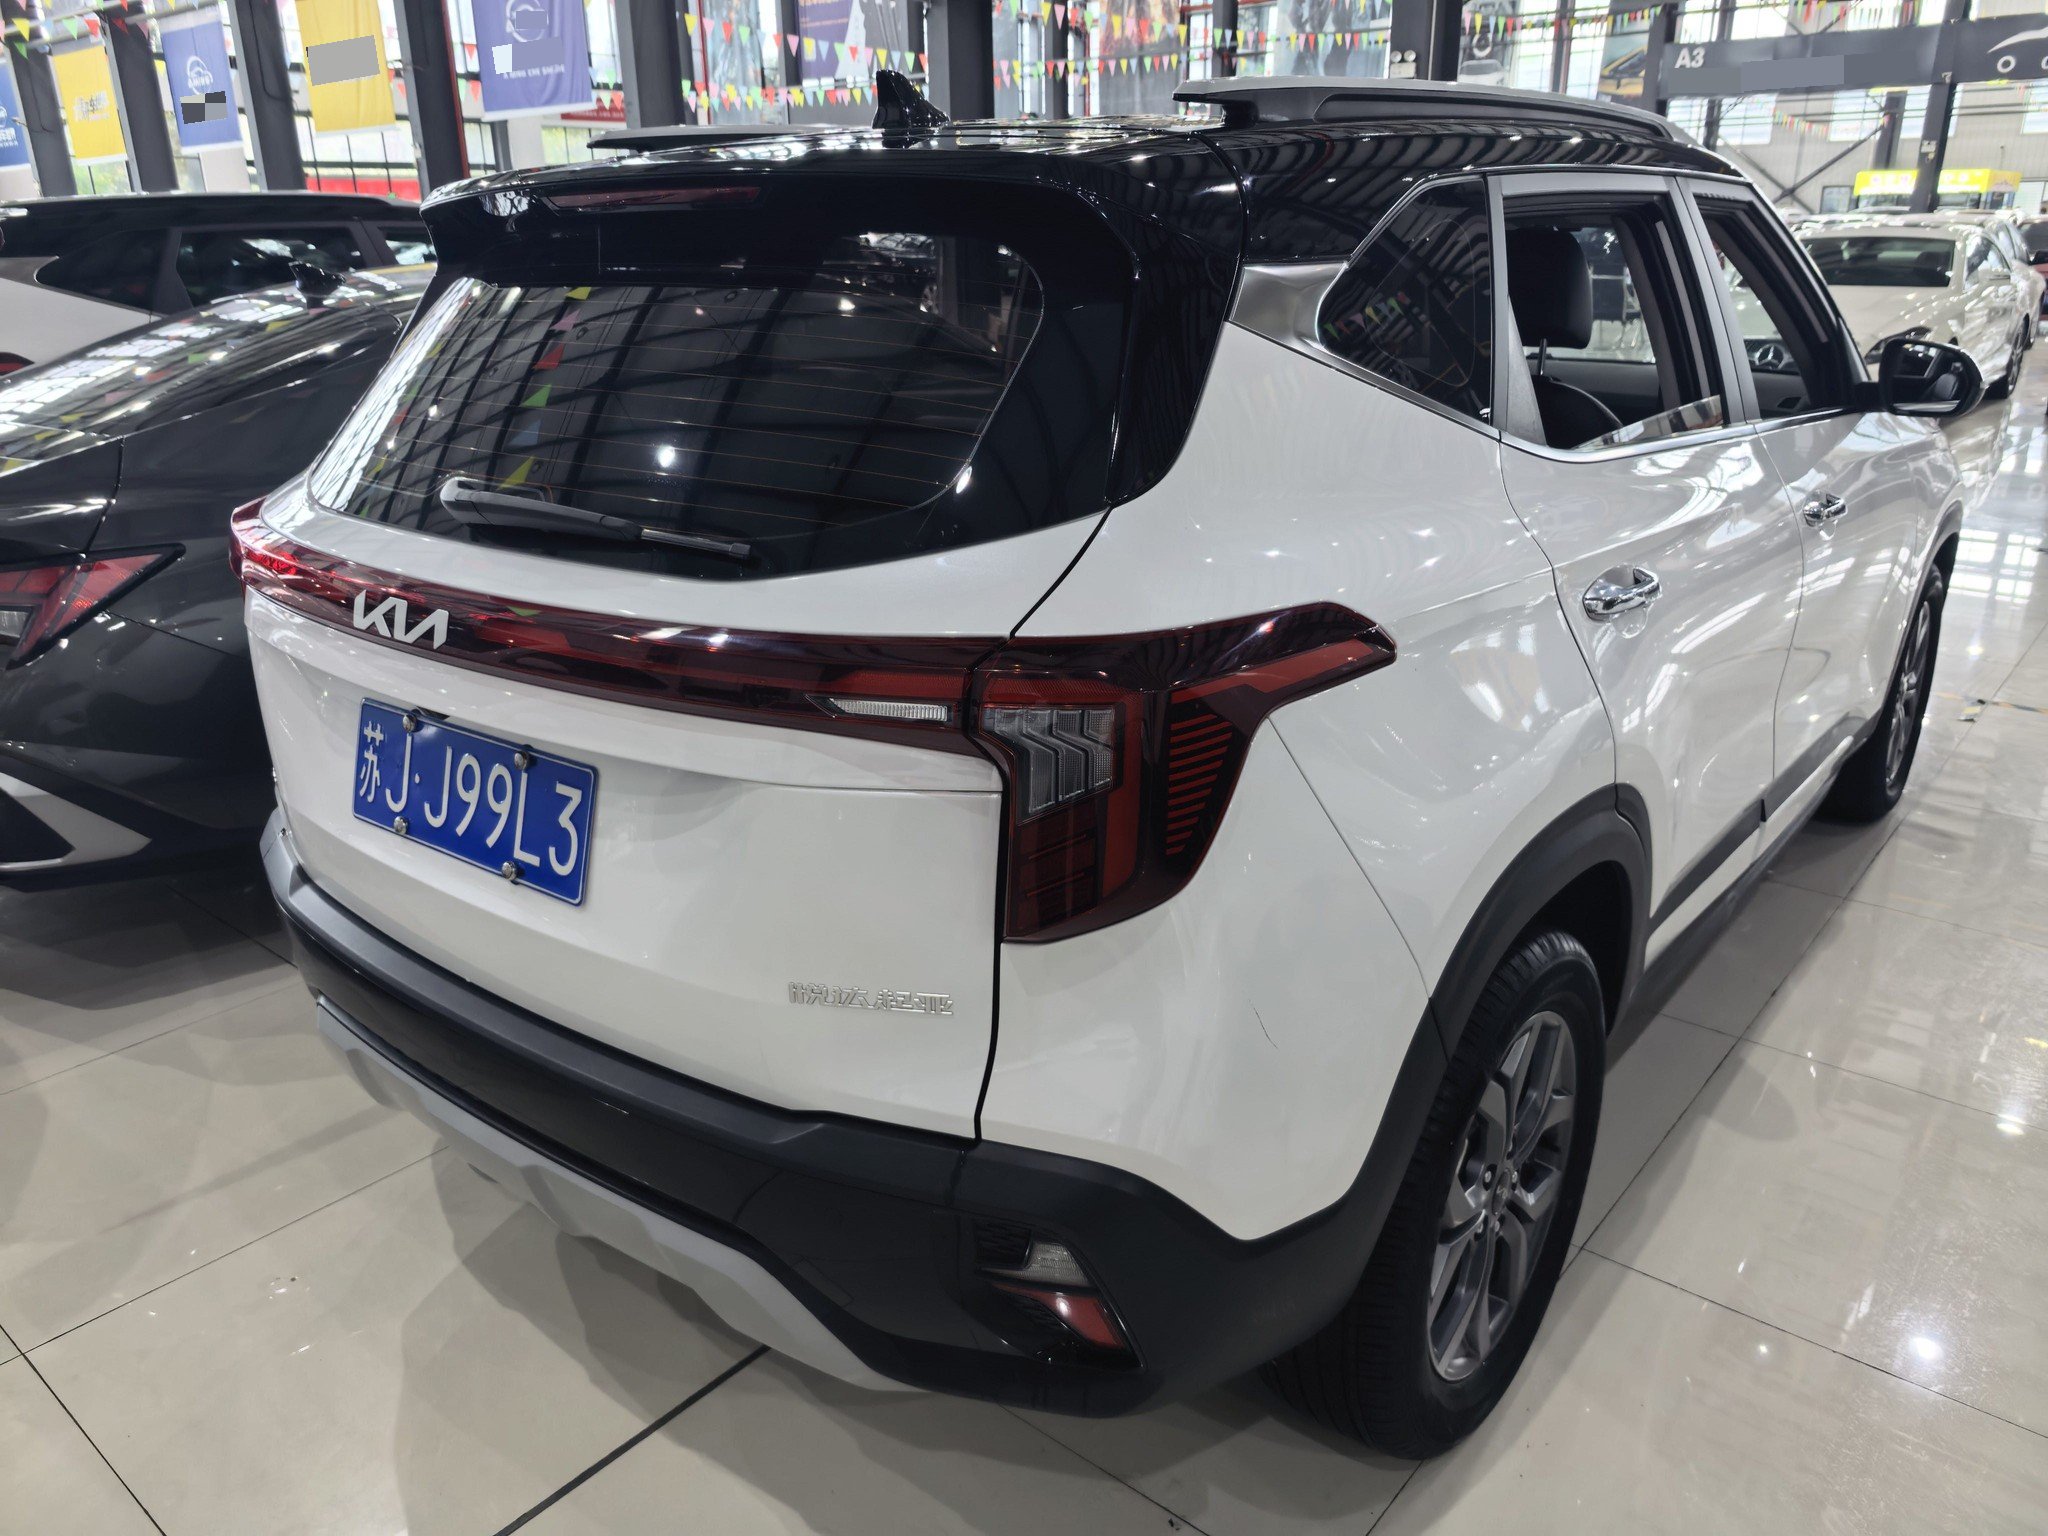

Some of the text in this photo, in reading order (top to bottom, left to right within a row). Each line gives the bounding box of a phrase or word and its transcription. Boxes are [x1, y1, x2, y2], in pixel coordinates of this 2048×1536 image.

[1674, 47, 1706, 69] A3
[353, 589, 450, 650] KIA
[787, 980, 954, 1017] 悦达起亚
